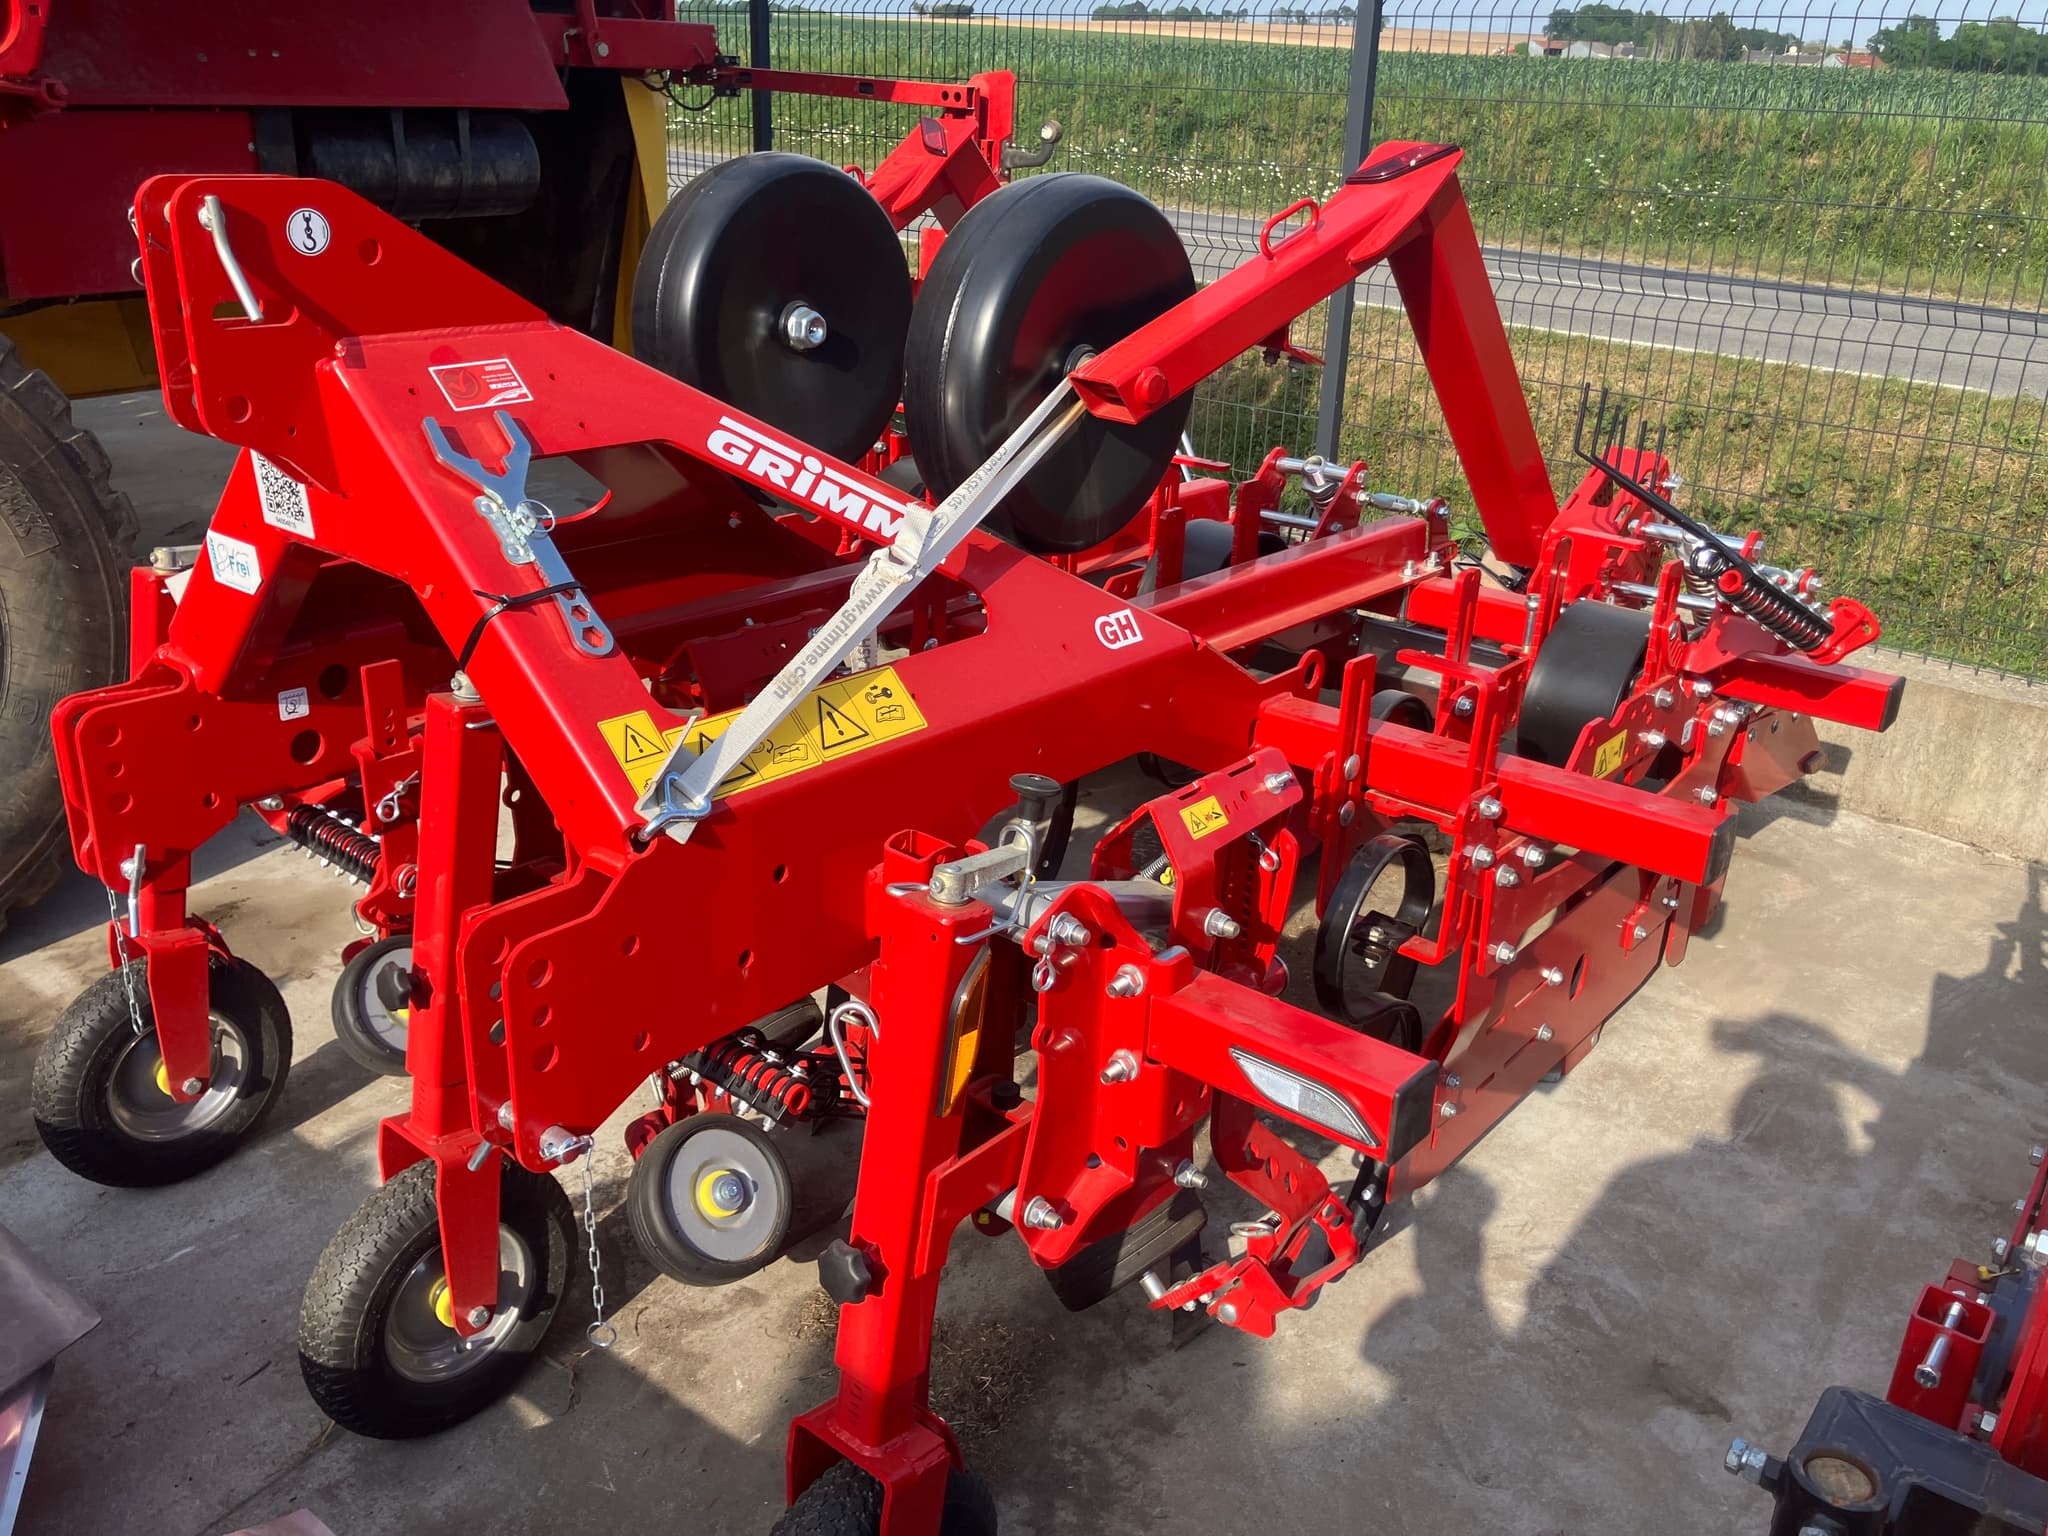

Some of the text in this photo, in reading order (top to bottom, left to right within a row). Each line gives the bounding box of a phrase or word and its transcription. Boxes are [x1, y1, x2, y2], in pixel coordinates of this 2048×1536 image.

[707, 416, 905, 539] GRIMM
[773, 577, 891, 700] www.grimme.com
[1097, 611, 1140, 647] GH
